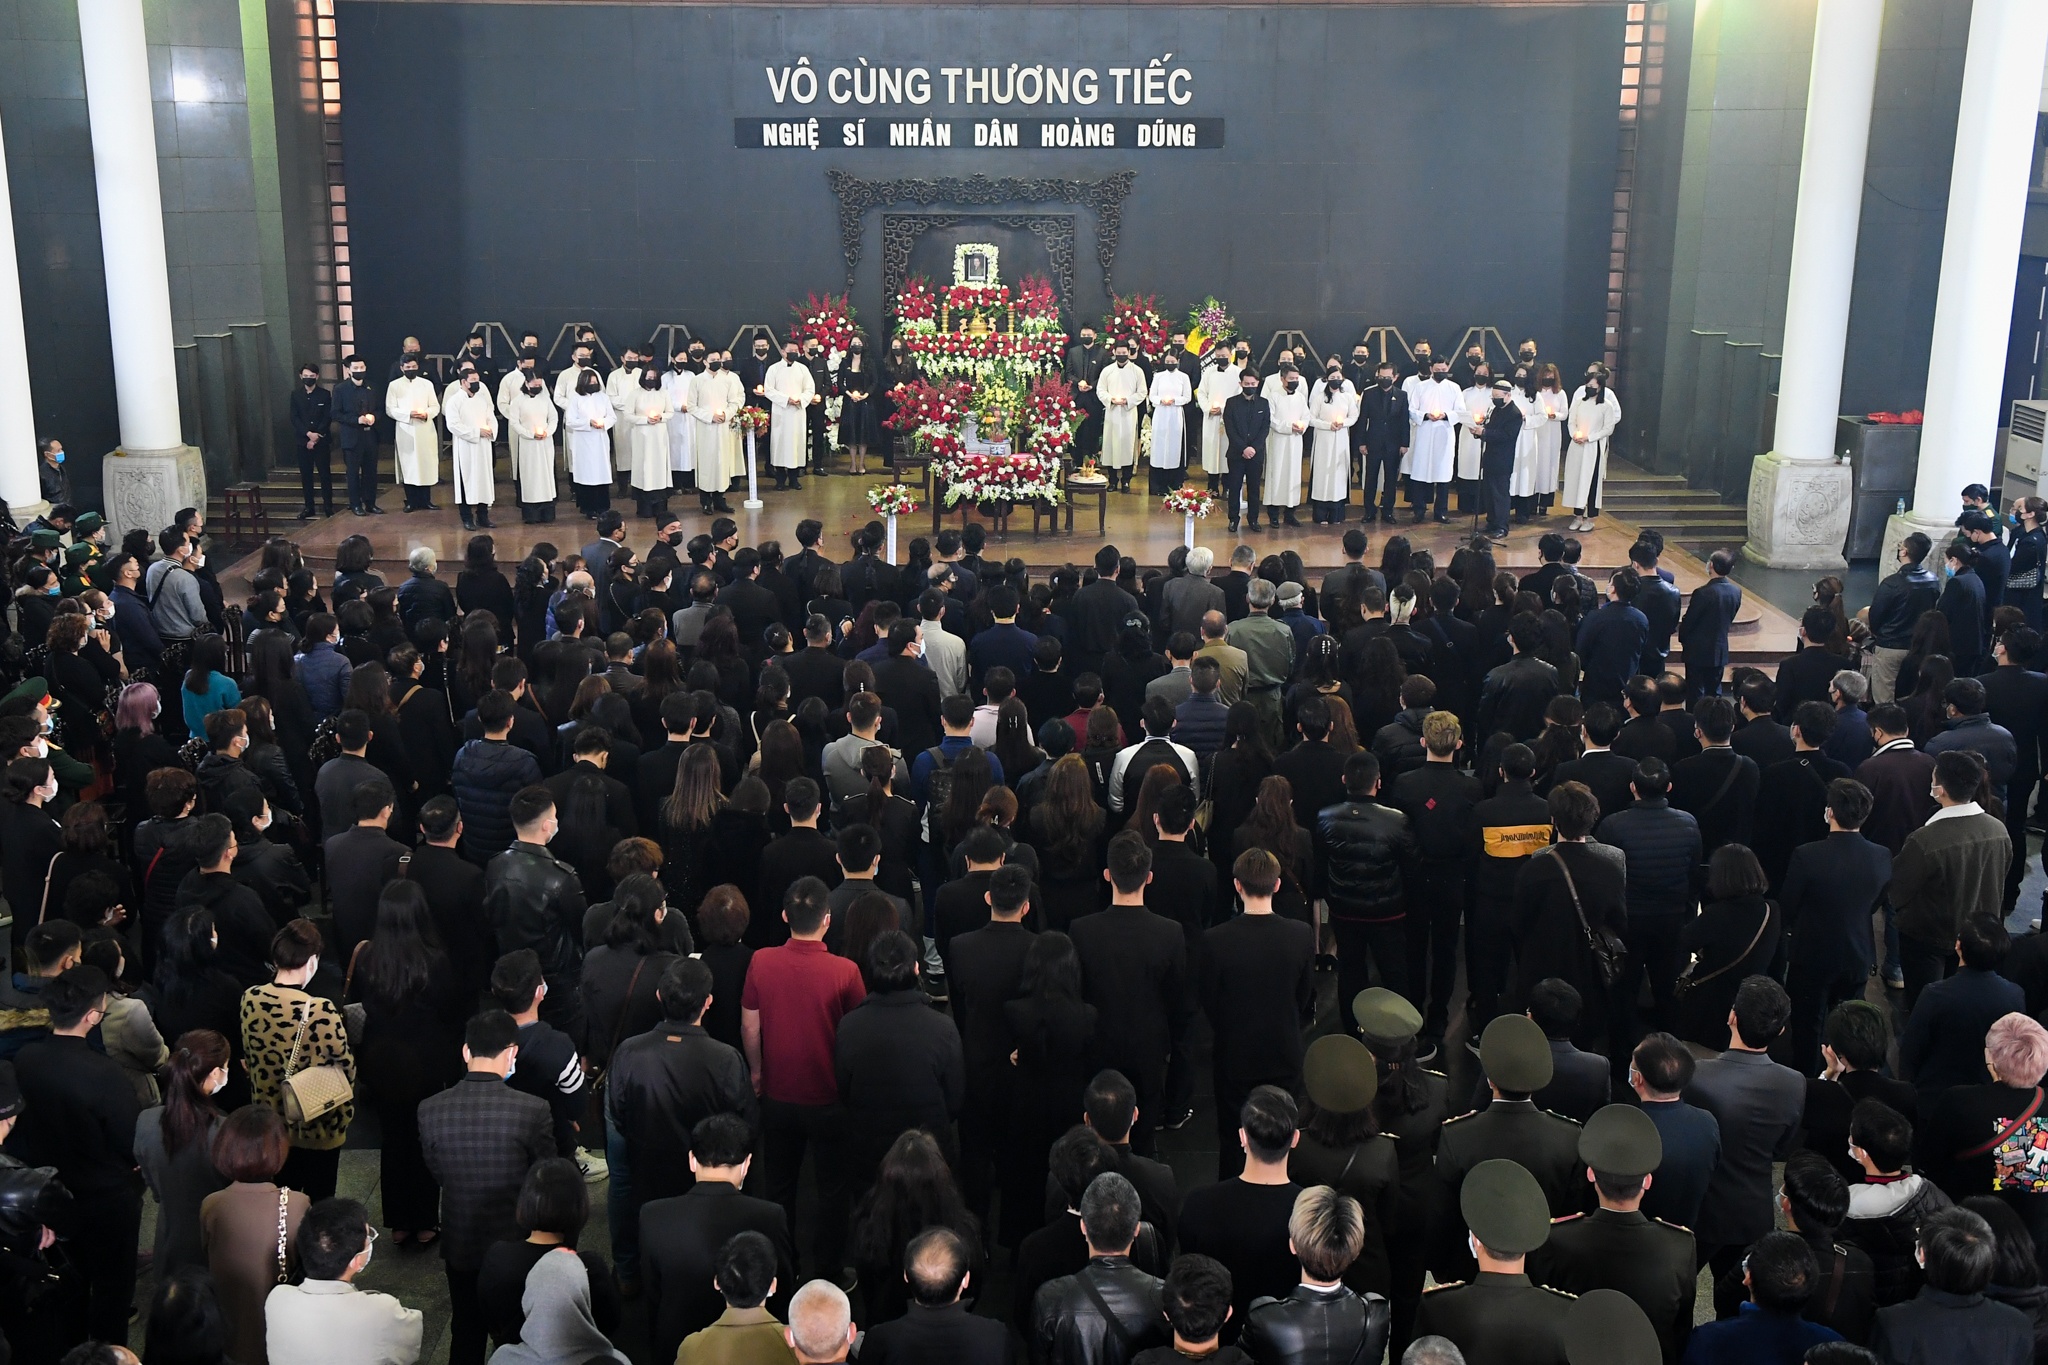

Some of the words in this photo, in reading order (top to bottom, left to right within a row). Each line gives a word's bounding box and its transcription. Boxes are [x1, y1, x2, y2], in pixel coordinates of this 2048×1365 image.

[765, 56, 818, 104] VÔ
[827, 56, 931, 105] CÙNG
[940, 62, 1099, 105] THƯƠNG
[1108, 52, 1193, 106] TIẾC
[762, 117, 820, 151] NGHỆ
[842, 117, 866, 147] SĨ
[889, 117, 951, 147] NHÂN
[974, 117, 1019, 147] DÂN
[1041, 116, 1115, 147] HOÀNG
[1137, 118, 1196, 147] DŨNG
